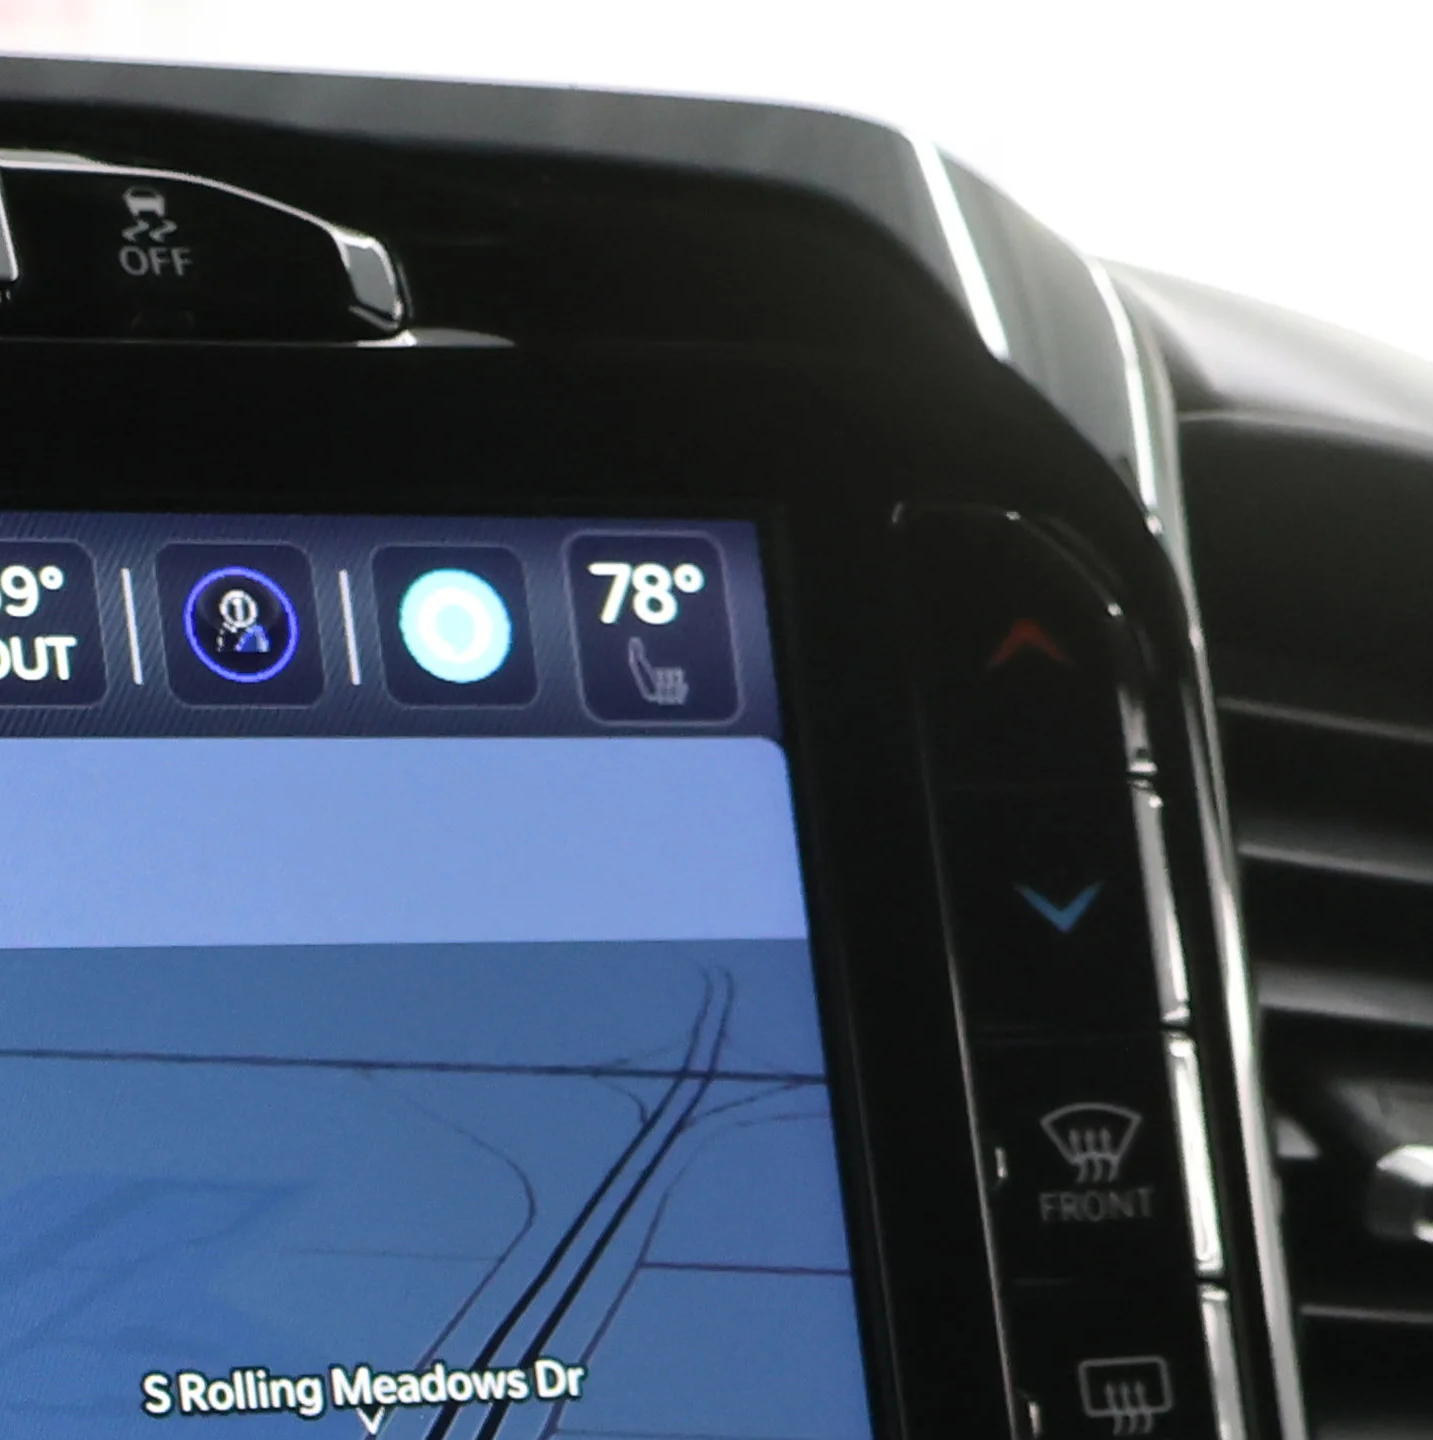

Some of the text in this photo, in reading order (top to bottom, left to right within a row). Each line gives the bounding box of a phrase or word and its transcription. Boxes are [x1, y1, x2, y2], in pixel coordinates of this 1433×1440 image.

[118, 245, 193, 279] OFF
[587, 561, 704, 626] 78°
[1038, 1186, 1152, 1223] FRONT
[142, 1358, 585, 1417] S Rolling Meadows Dr
